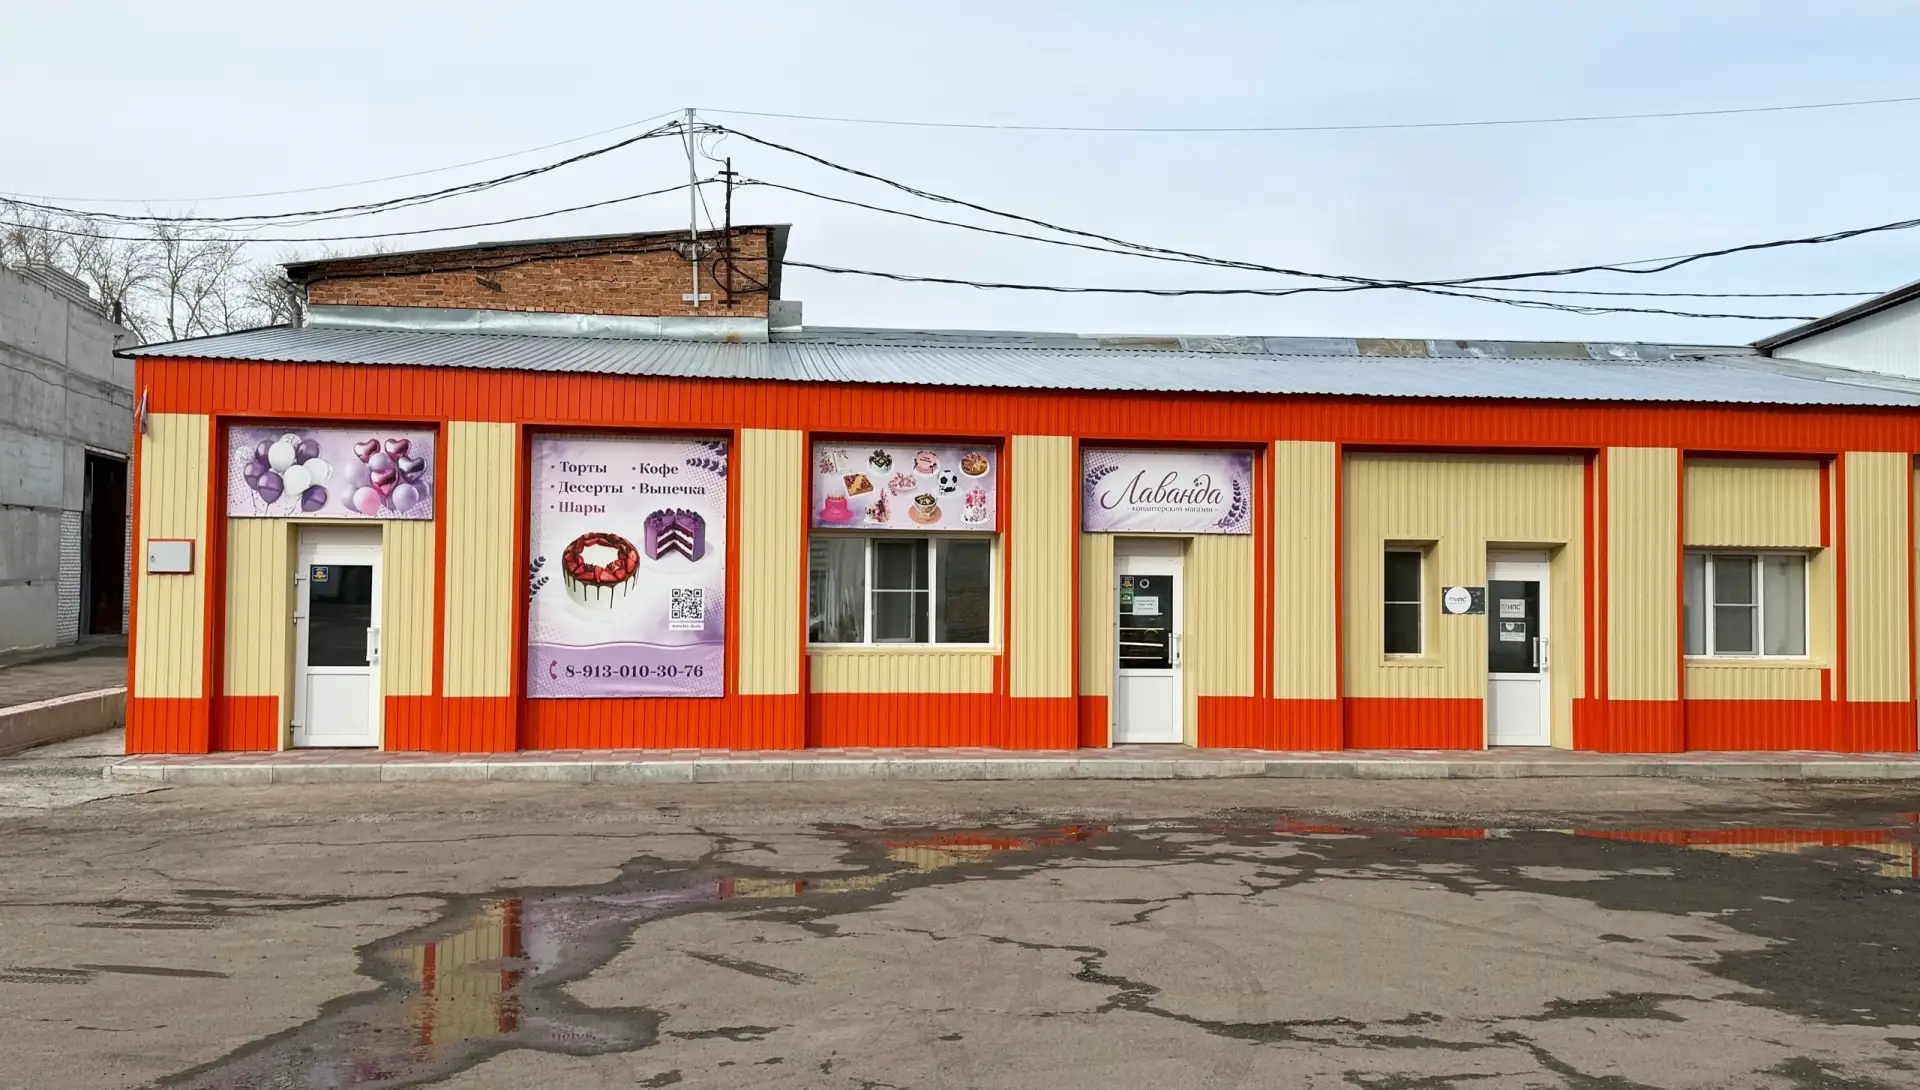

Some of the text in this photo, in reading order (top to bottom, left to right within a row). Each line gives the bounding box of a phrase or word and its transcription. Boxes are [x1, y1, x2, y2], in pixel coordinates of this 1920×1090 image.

[560, 461, 607, 476] Торты
[639, 463, 679, 478] Кофе
[558, 481, 623, 496] Десерты
[639, 483, 706, 496] Выпечка
[1100, 469, 1224, 510] Лаванда
[558, 501, 606, 516] Шары
[565, 664, 704, 679] 8-913-010-30-76
